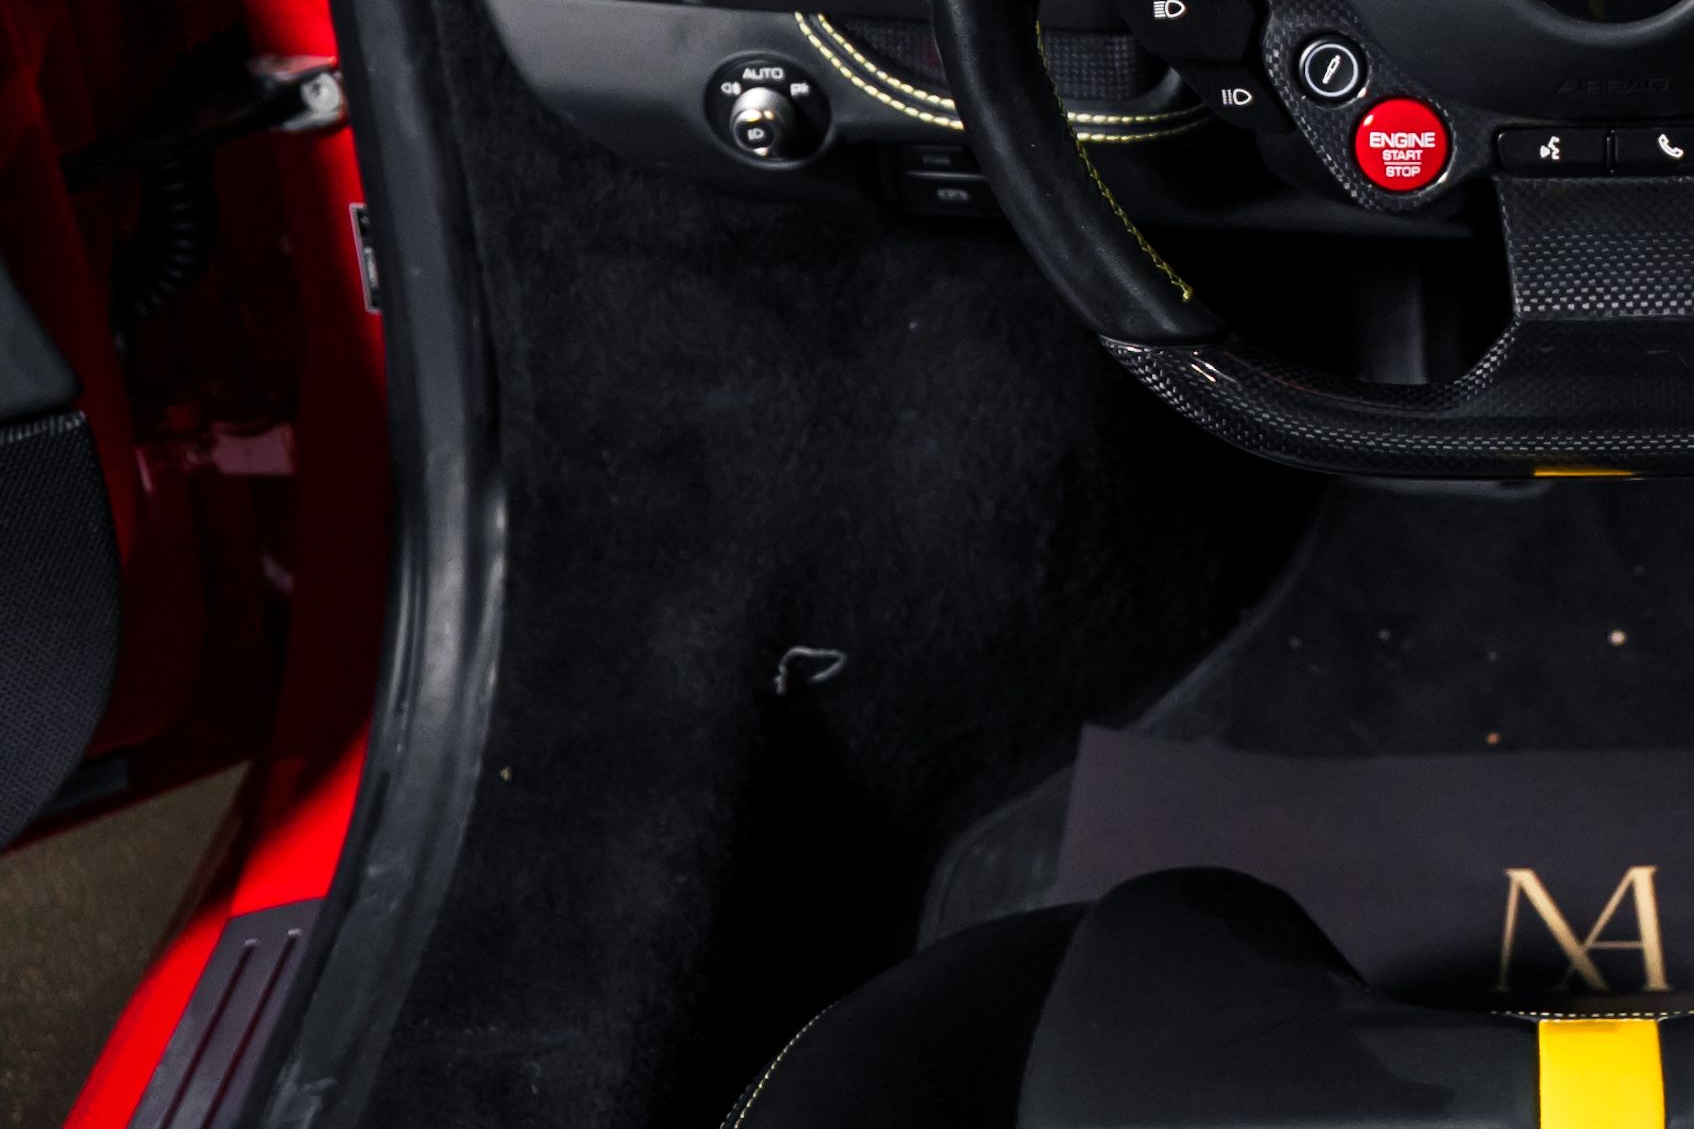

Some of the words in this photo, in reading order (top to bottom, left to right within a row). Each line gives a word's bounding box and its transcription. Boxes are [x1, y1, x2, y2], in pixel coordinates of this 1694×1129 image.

[742, 67, 784, 80] AUTO
[1368, 131, 1436, 148] ENGINE
[1382, 150, 1423, 161] START
[1385, 166, 1421, 178] STOP
